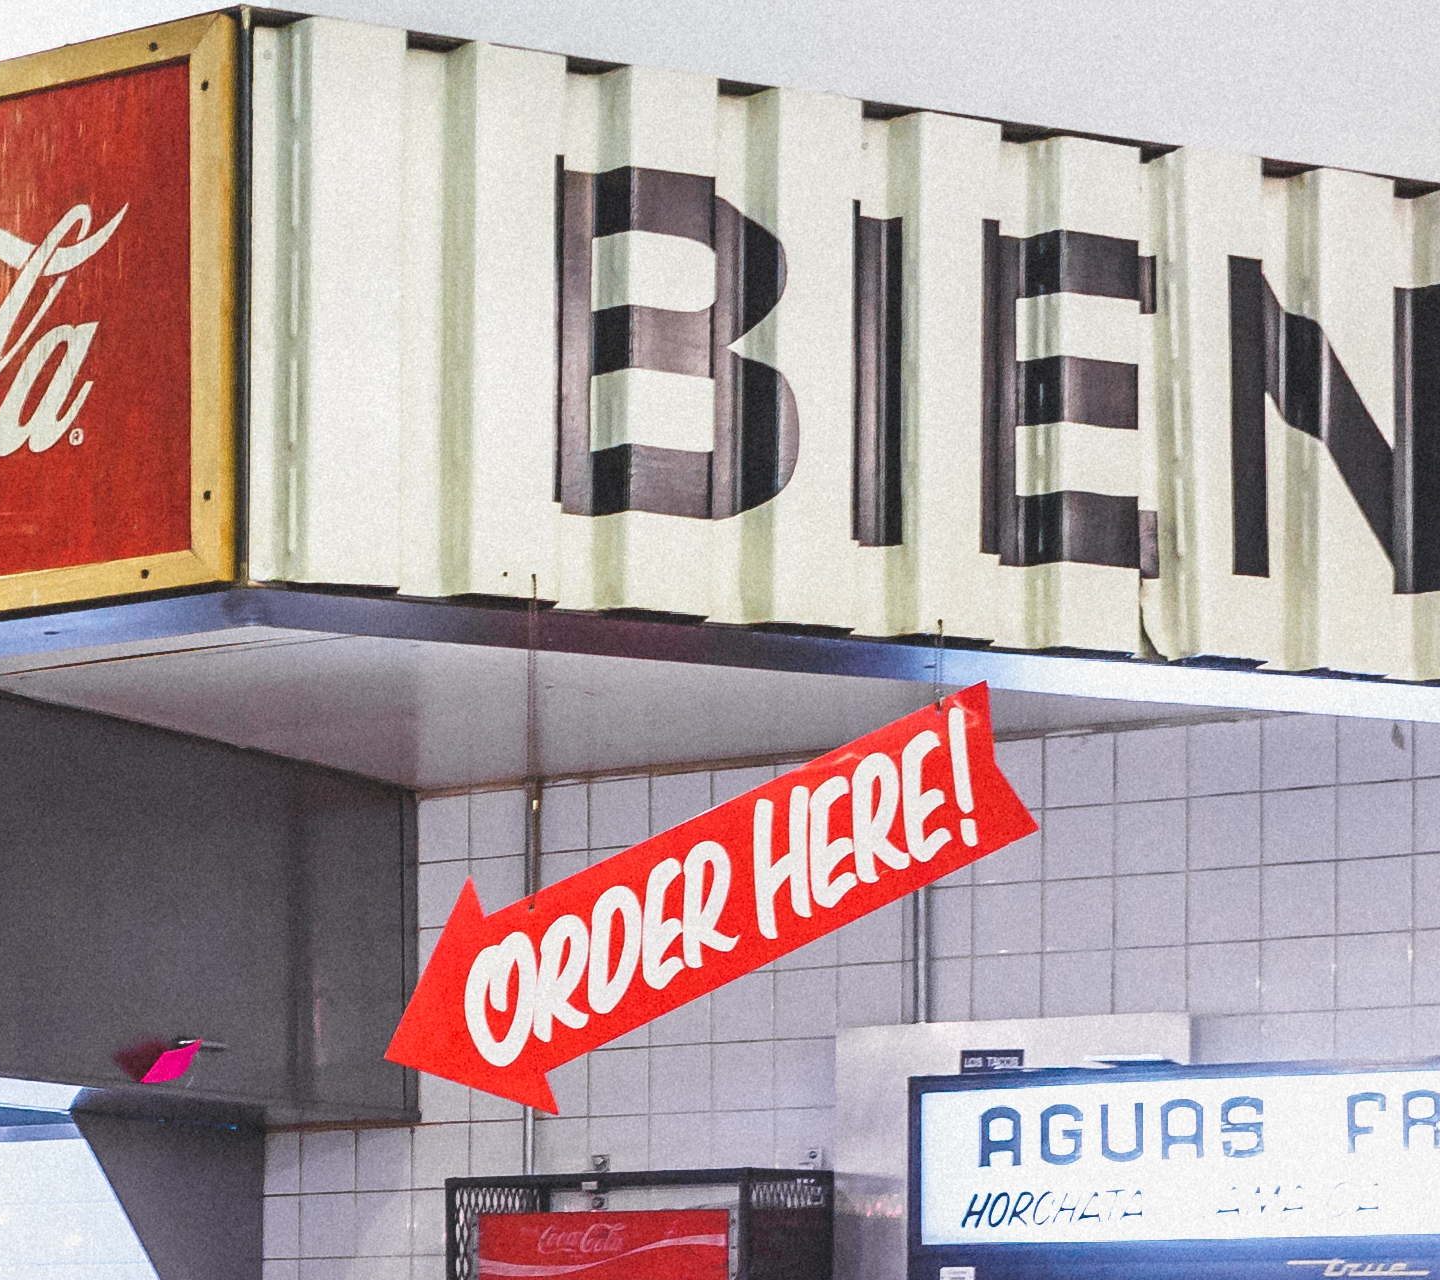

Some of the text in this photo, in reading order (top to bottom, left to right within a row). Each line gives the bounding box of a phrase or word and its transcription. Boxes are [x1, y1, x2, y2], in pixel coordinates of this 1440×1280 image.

[464, 706, 980, 1069] ORDER HERE!
[977, 1095, 1266, 1169] AGUAS
